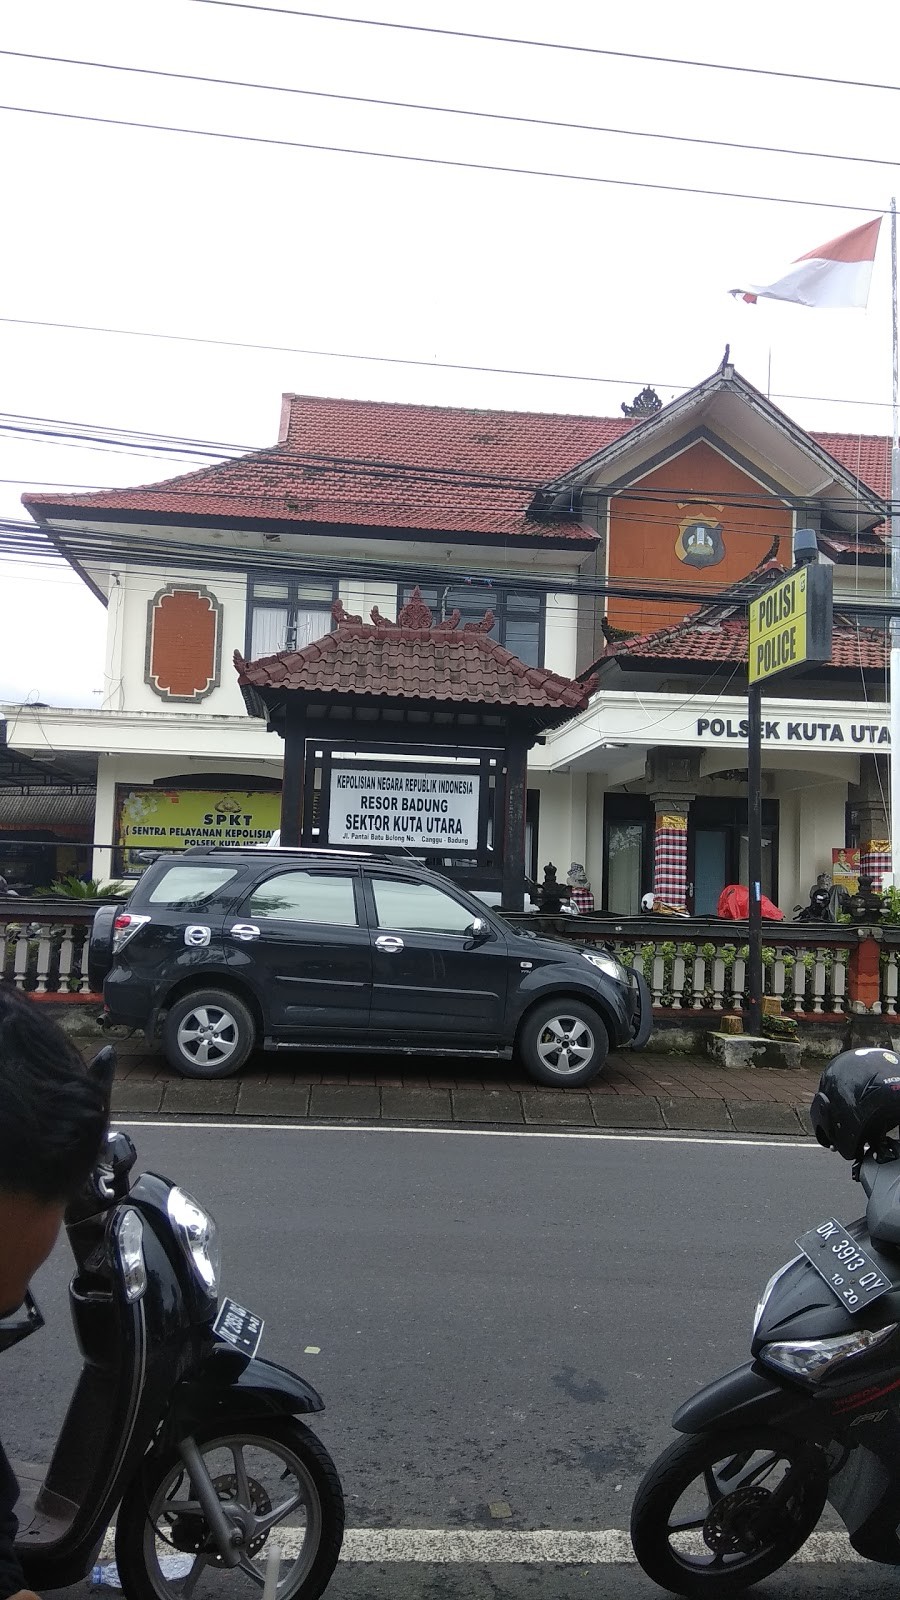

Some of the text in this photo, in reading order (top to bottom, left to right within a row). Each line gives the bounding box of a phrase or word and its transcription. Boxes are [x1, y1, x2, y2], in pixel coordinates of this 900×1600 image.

[758, 580, 796, 633] POLISI
[757, 626, 797, 676] POLICE
[787, 722, 844, 742] KUTA
[337, 775, 473, 794] KEPOLISIAN NEGARA REPUBLIK INDONESIA
[360, 795, 448, 813] RESOR BADUNG
[203, 814, 253, 826] SPKT
[345, 814, 463, 835] SEKTOR KUTA UTARA
[132, 826, 166, 836] SENTRA
[169, 827, 222, 838] PELAYANAN
[421, 836, 443, 844] Canggu
[447, 837, 469, 846] Badung
[184, 839, 216, 847] POLSEK
[816, 1221, 885, 1292] DK 3913 QY
[831, 1273, 859, 1305] 10 20
